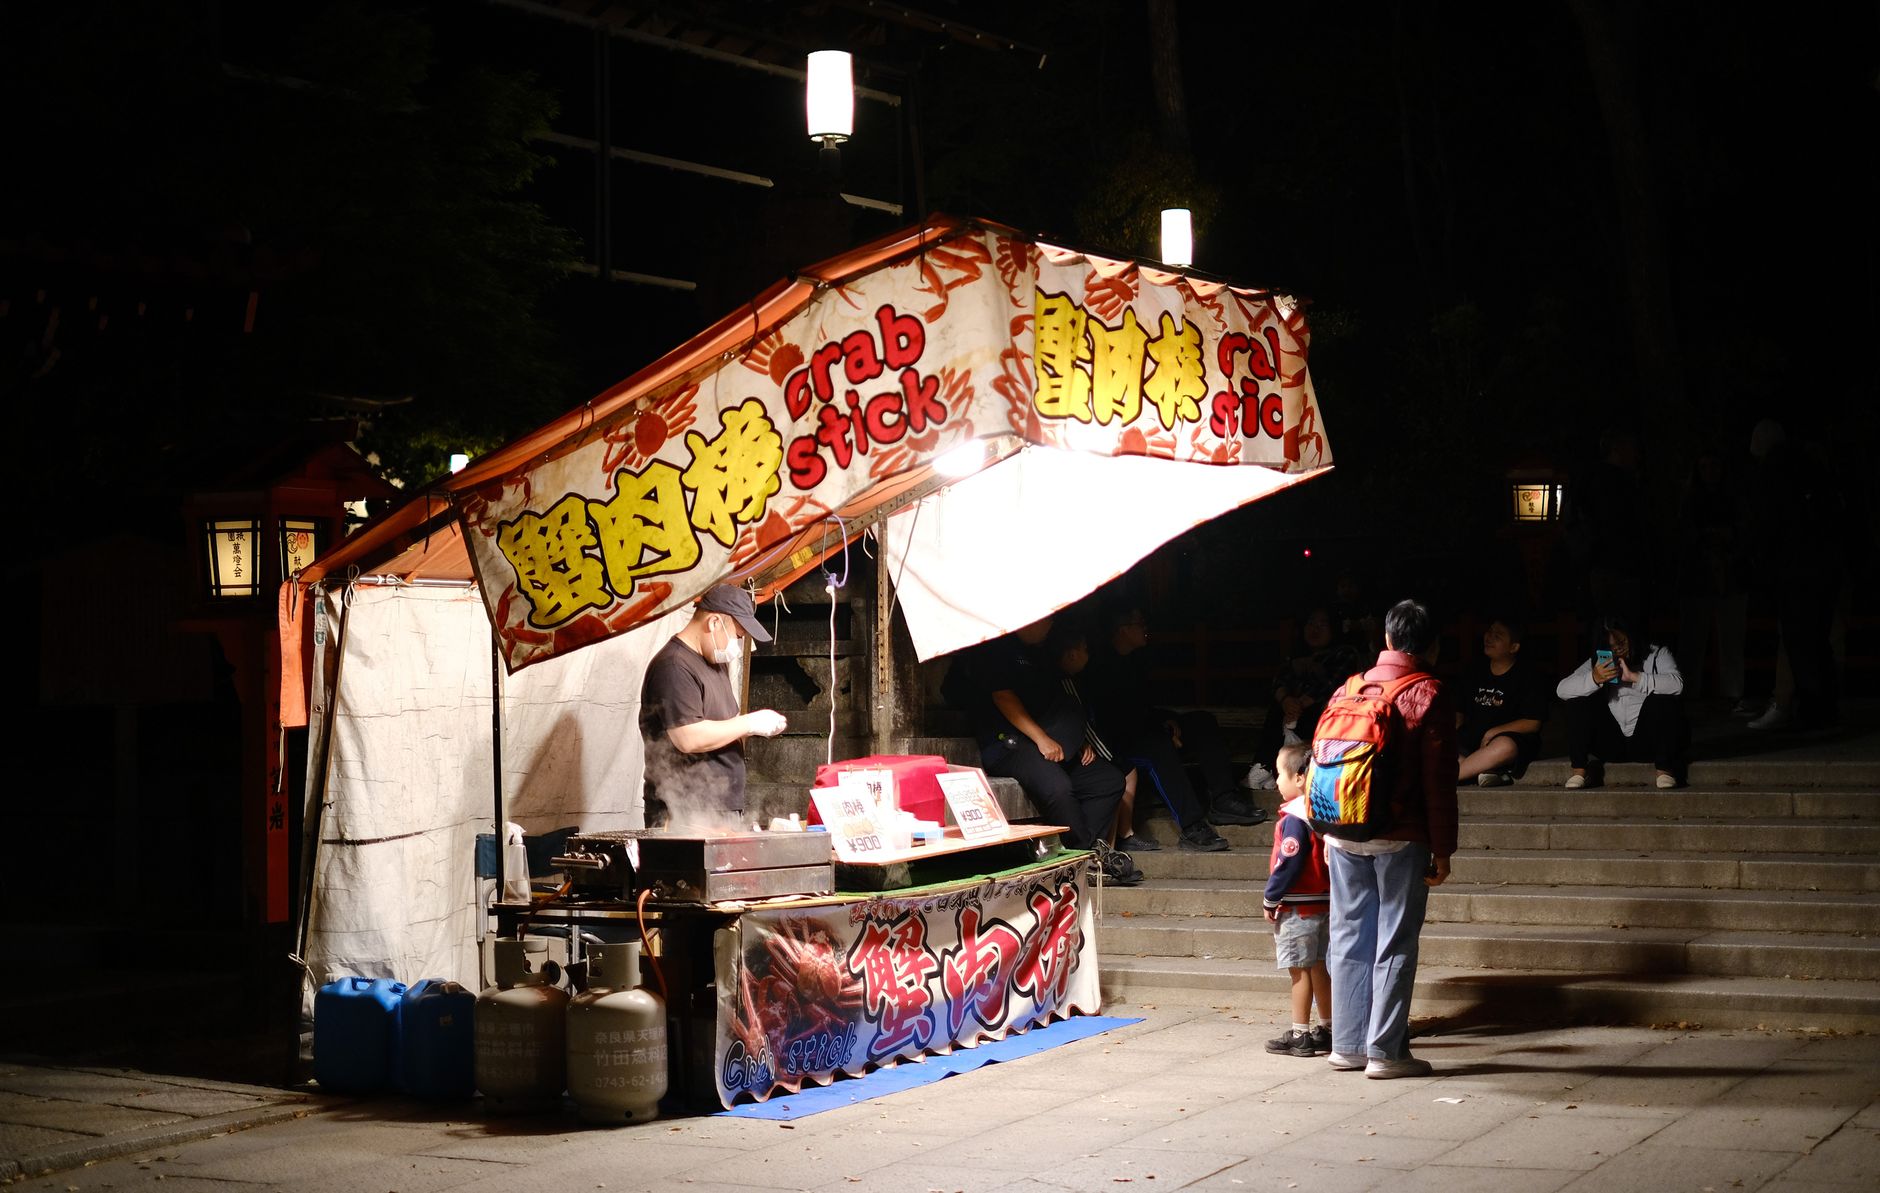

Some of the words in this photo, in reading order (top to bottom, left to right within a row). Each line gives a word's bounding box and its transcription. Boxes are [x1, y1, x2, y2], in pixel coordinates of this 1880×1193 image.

[784, 304, 926, 422] crab
[787, 367, 947, 490] stick
[496, 397, 784, 629] 蟹肉棒
[846, 835, 882, 853] ¥900
[960, 808, 983, 822] ¥900
[848, 884, 1084, 1060] 蟹肉棒
[723, 1033, 775, 1091] Crab
